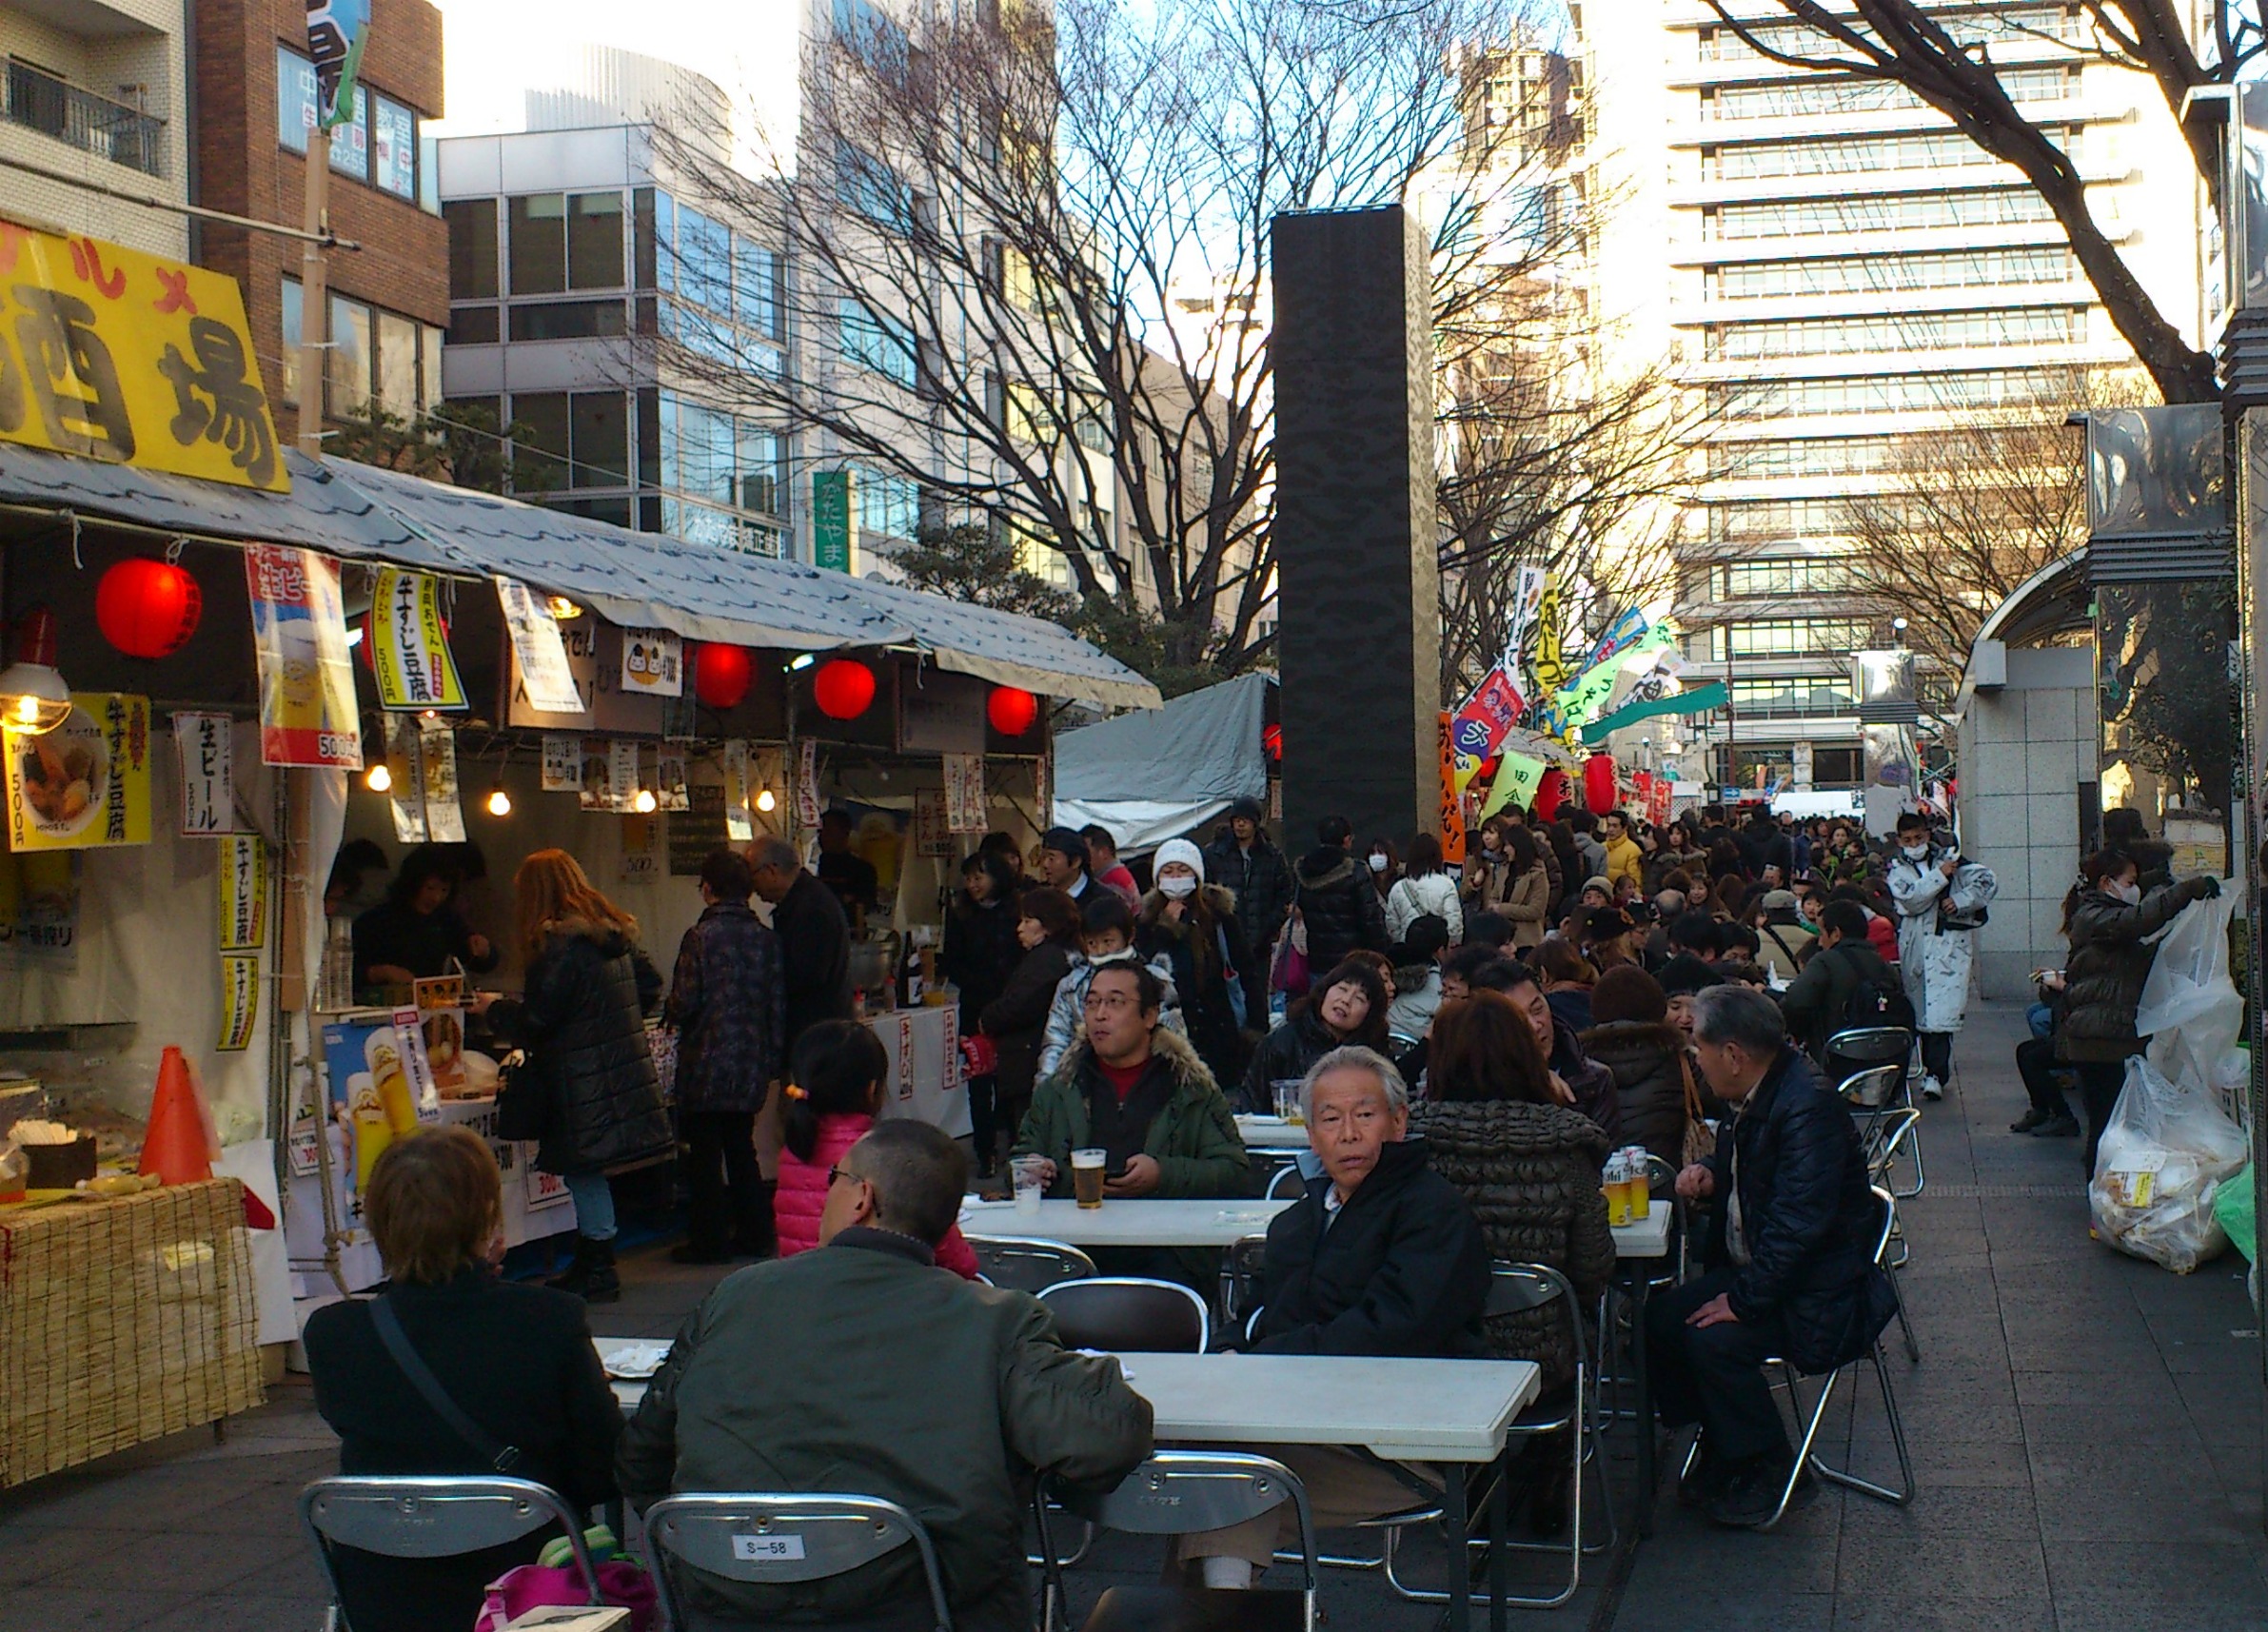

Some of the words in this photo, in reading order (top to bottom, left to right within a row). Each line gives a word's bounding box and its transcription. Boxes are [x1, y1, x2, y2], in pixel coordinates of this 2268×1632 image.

[0, 221, 198, 316] ルメ
[821, 482, 844, 571] かたやま
[200, 718, 218, 830] 生ビール
[746, 1542, 787, 1554] S-58
